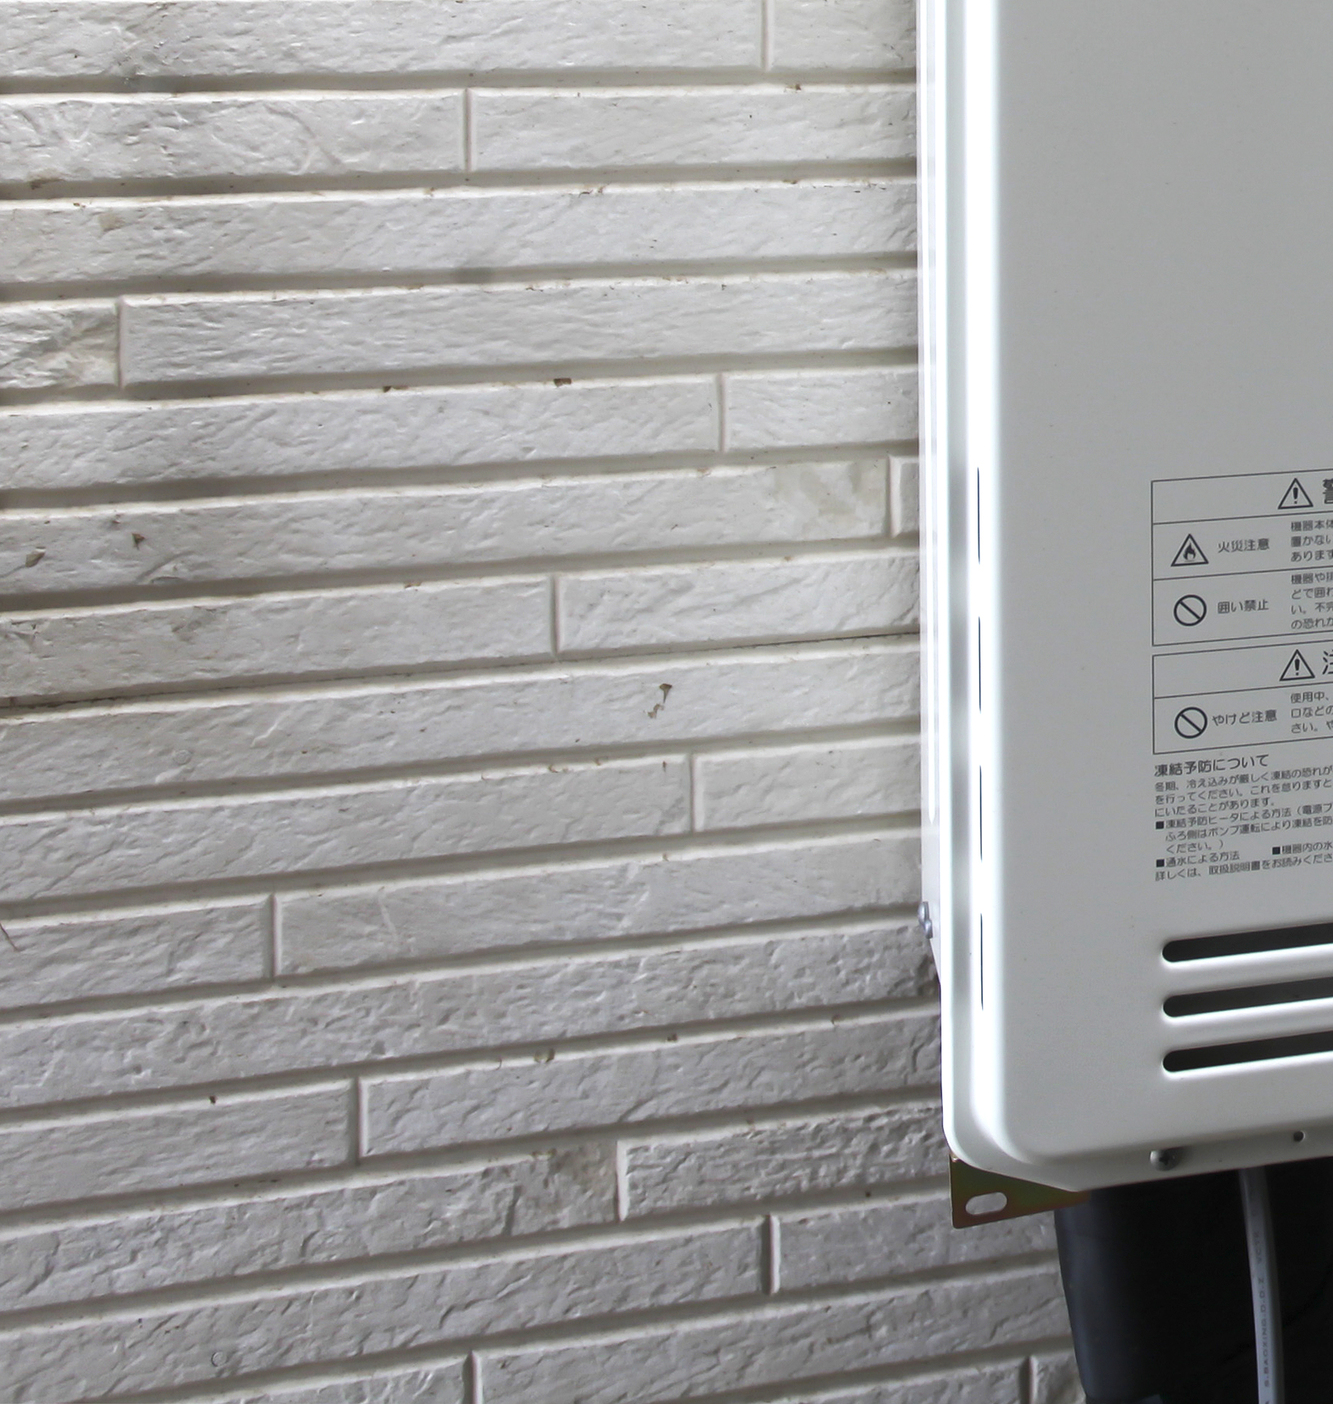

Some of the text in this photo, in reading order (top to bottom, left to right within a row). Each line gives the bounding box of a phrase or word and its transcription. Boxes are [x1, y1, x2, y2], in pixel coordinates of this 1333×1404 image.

[1217, 538, 1270, 554] 火災注意
[1217, 599, 1270, 615] 囲い禁止
[1211, 708, 1278, 726] やけど注意
[1153, 754, 1270, 778] 凍結予防について
[1154, 796, 1275, 818] にいたることがあります。
